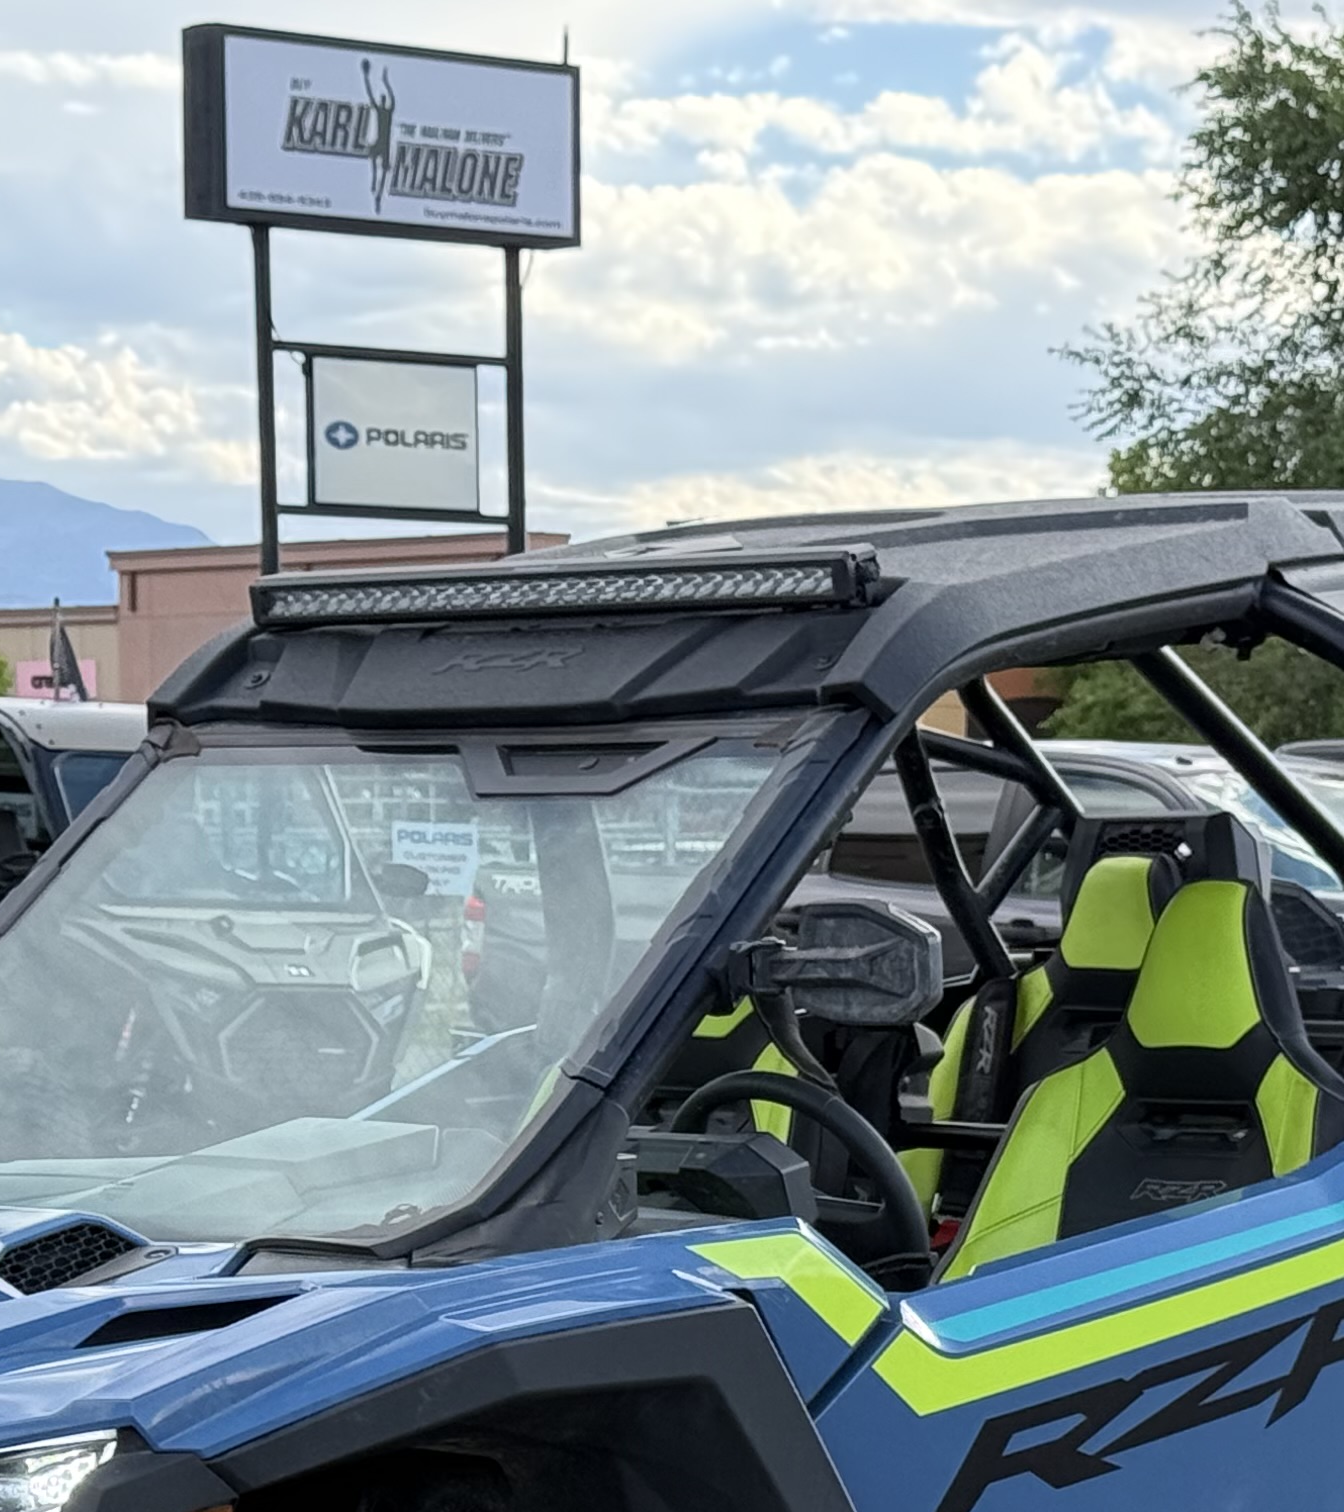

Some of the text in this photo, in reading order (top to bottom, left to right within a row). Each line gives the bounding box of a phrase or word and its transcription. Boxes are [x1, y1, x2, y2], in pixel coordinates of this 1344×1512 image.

[282, 95, 372, 158] KARL
[390, 141, 524, 207] MALONE
[365, 427, 470, 451] POLARIS
[396, 819, 473, 846] POLARIS
[975, 1005, 998, 1074] RZR
[1130, 1177, 1229, 1201] RZR
